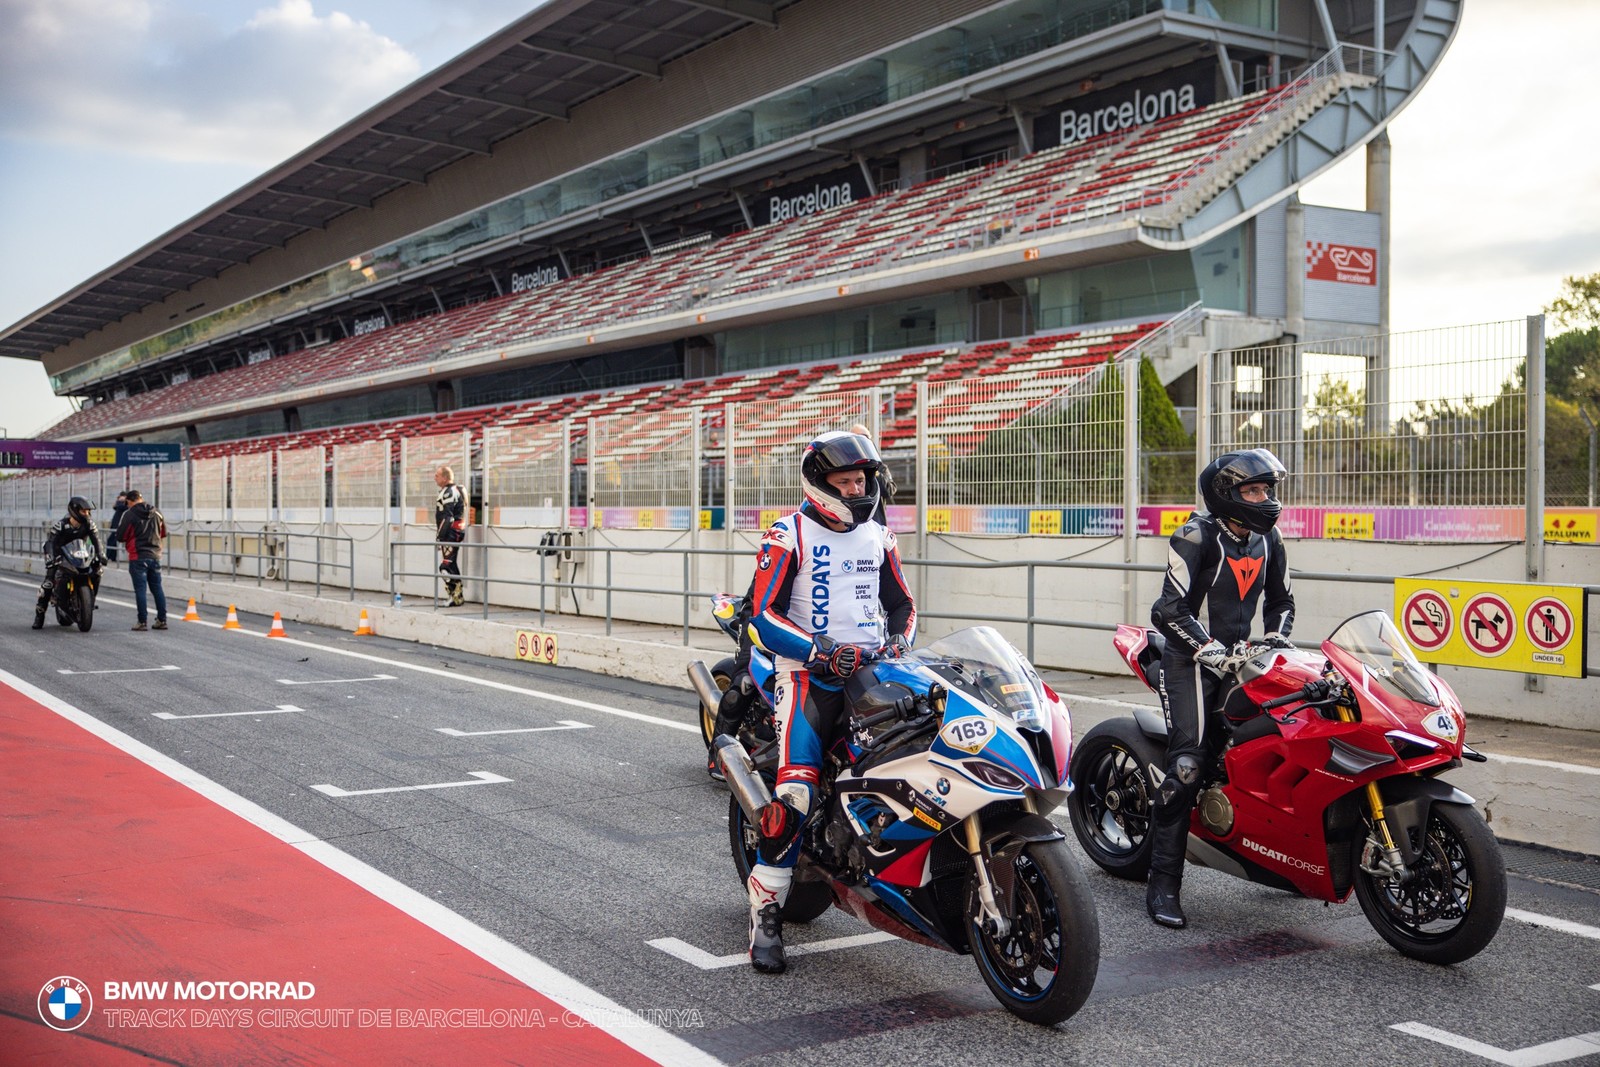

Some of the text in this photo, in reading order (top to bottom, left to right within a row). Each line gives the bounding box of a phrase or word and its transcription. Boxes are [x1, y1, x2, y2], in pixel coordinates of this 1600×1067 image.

[1060, 84, 1196, 145] Barcelona
[770, 182, 852, 224] Barcelona
[511, 265, 559, 293] Barcelona
[1543, 530, 1591, 538] ATALUNYA
[811, 544, 831, 635] CKDAYS
[1534, 654, 1554, 662] UNDER
[951, 720, 988, 742] 163
[1242, 837, 1325, 876] DUCATI CORSE
